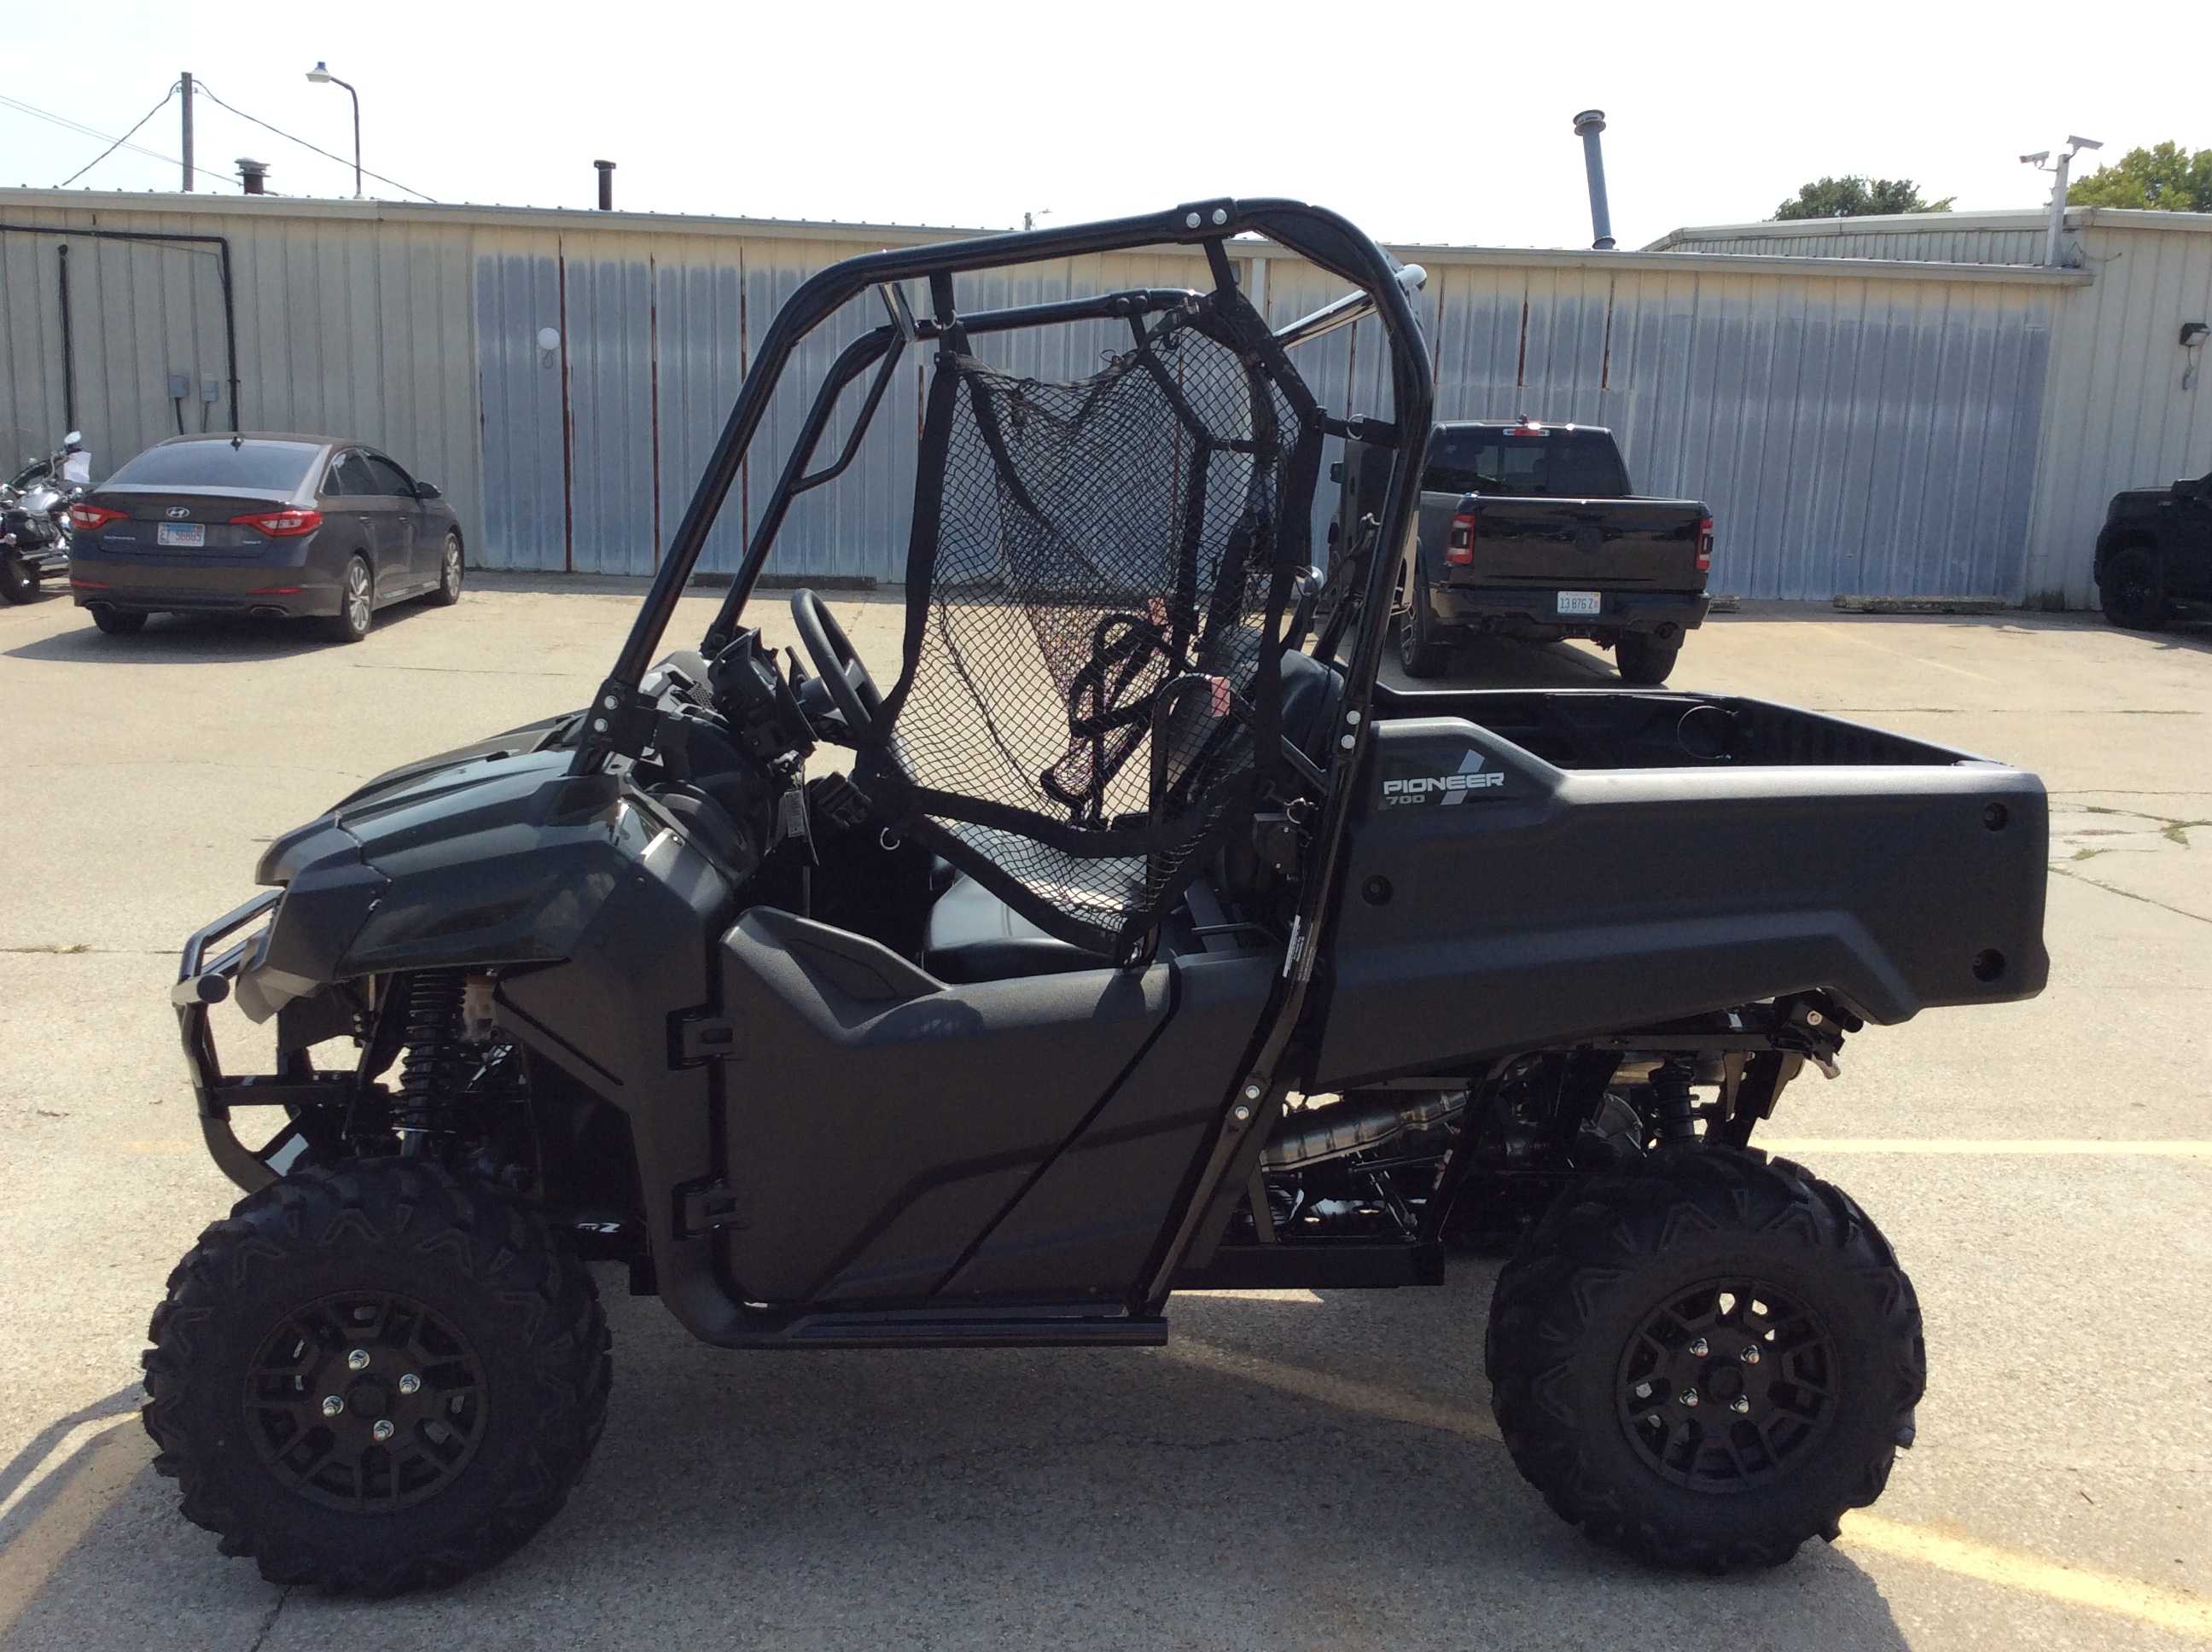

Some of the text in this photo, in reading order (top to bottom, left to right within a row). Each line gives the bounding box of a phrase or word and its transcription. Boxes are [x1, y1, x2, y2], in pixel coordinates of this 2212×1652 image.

[1560, 597, 1570, 608] 13
[1572, 598, 1586, 609] 876
[1383, 772, 1505, 794] PIONEER
[1386, 794, 1425, 805] 700
